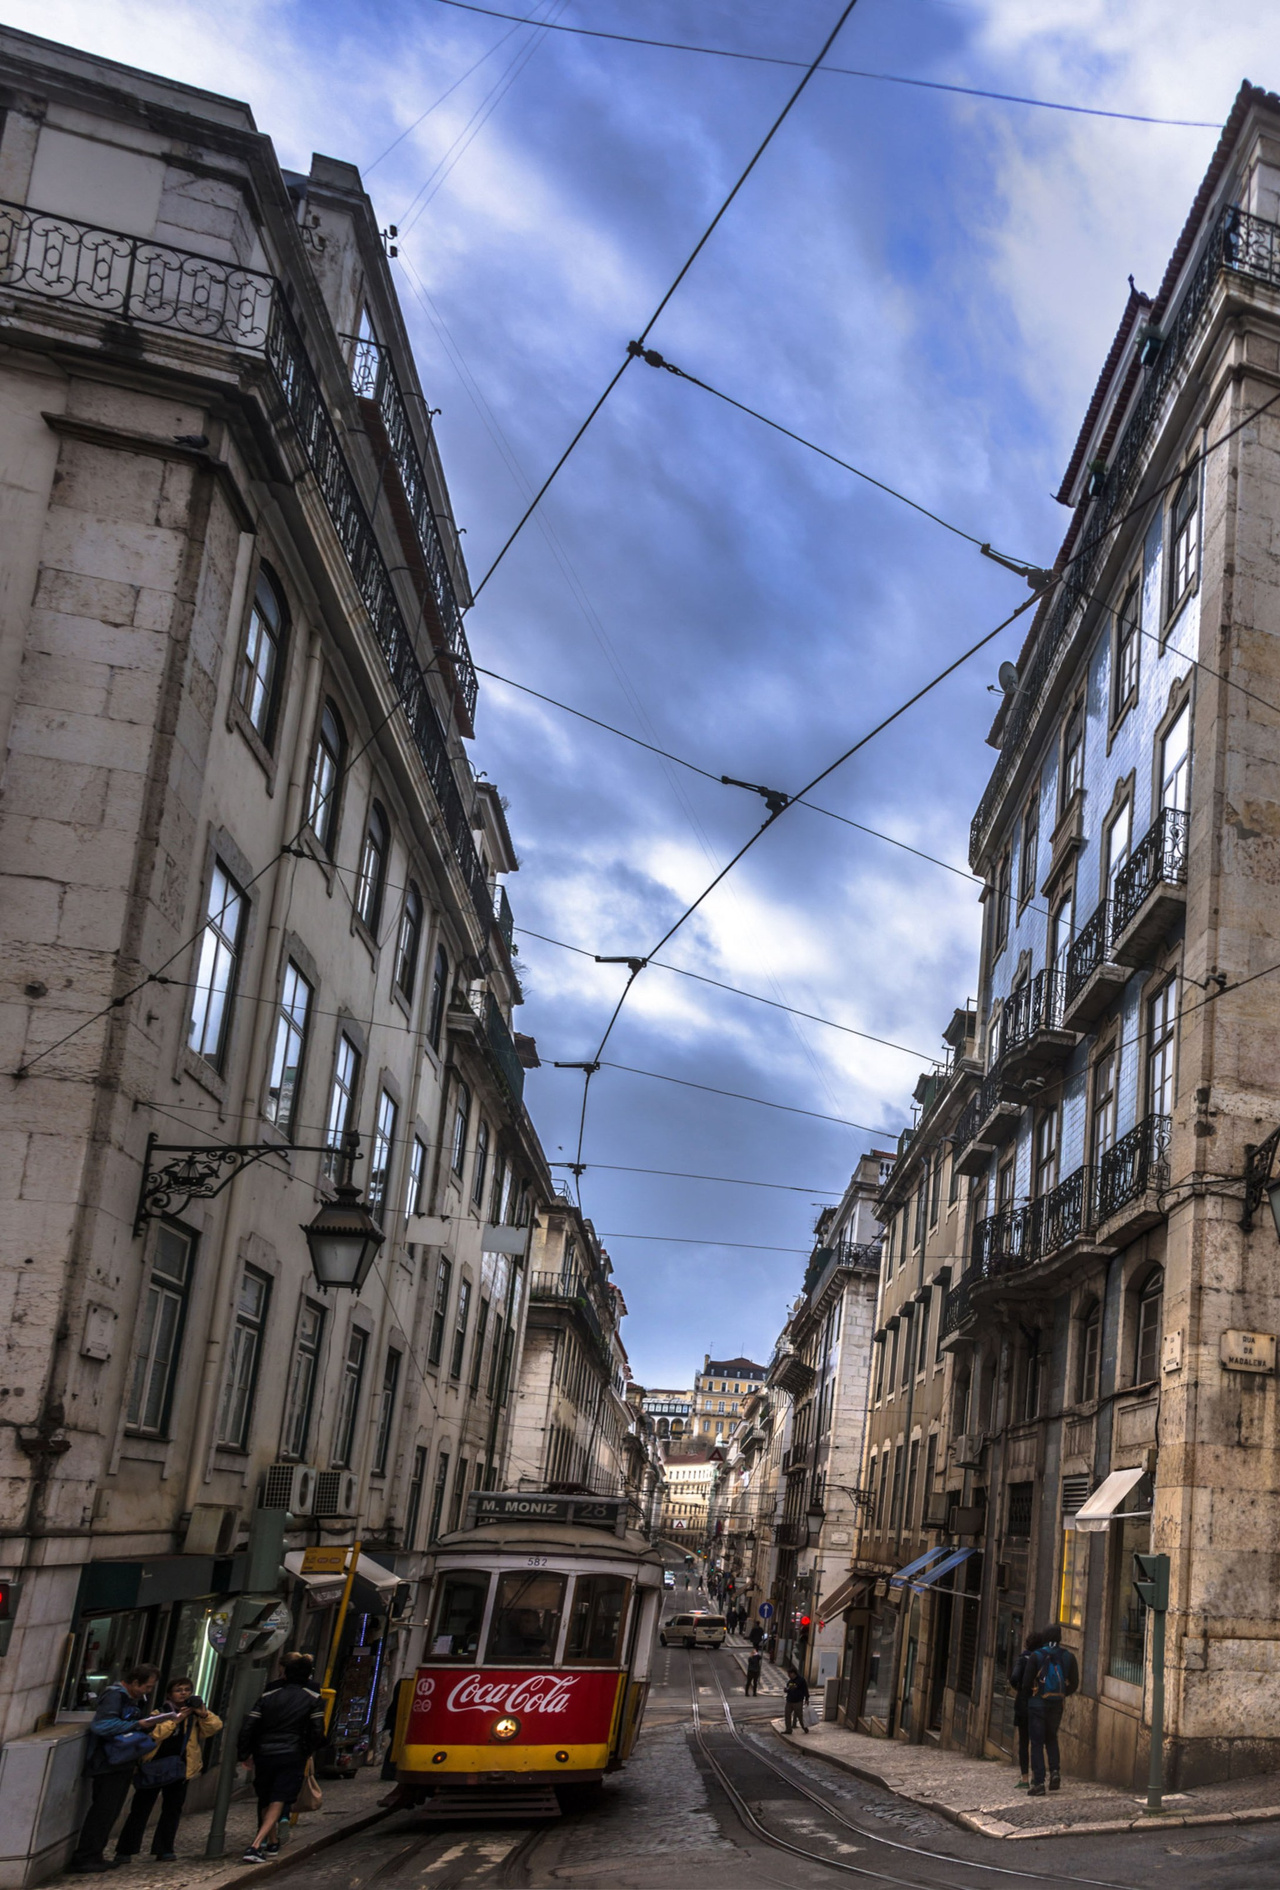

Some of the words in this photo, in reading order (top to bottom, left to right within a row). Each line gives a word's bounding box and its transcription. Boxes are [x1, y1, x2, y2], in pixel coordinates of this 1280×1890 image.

[1242, 1335, 1256, 1344] RUA
[1244, 1347, 1253, 1355] DA
[1229, 1356, 1267, 1367] MADALENA
[481, 1500, 500, 1511] M.
[505, 1501, 558, 1514] MONIZ
[580, 1503, 607, 1517] 28
[527, 1557, 548, 1567] 582
[446, 1673, 581, 1713] Coca-Cola
